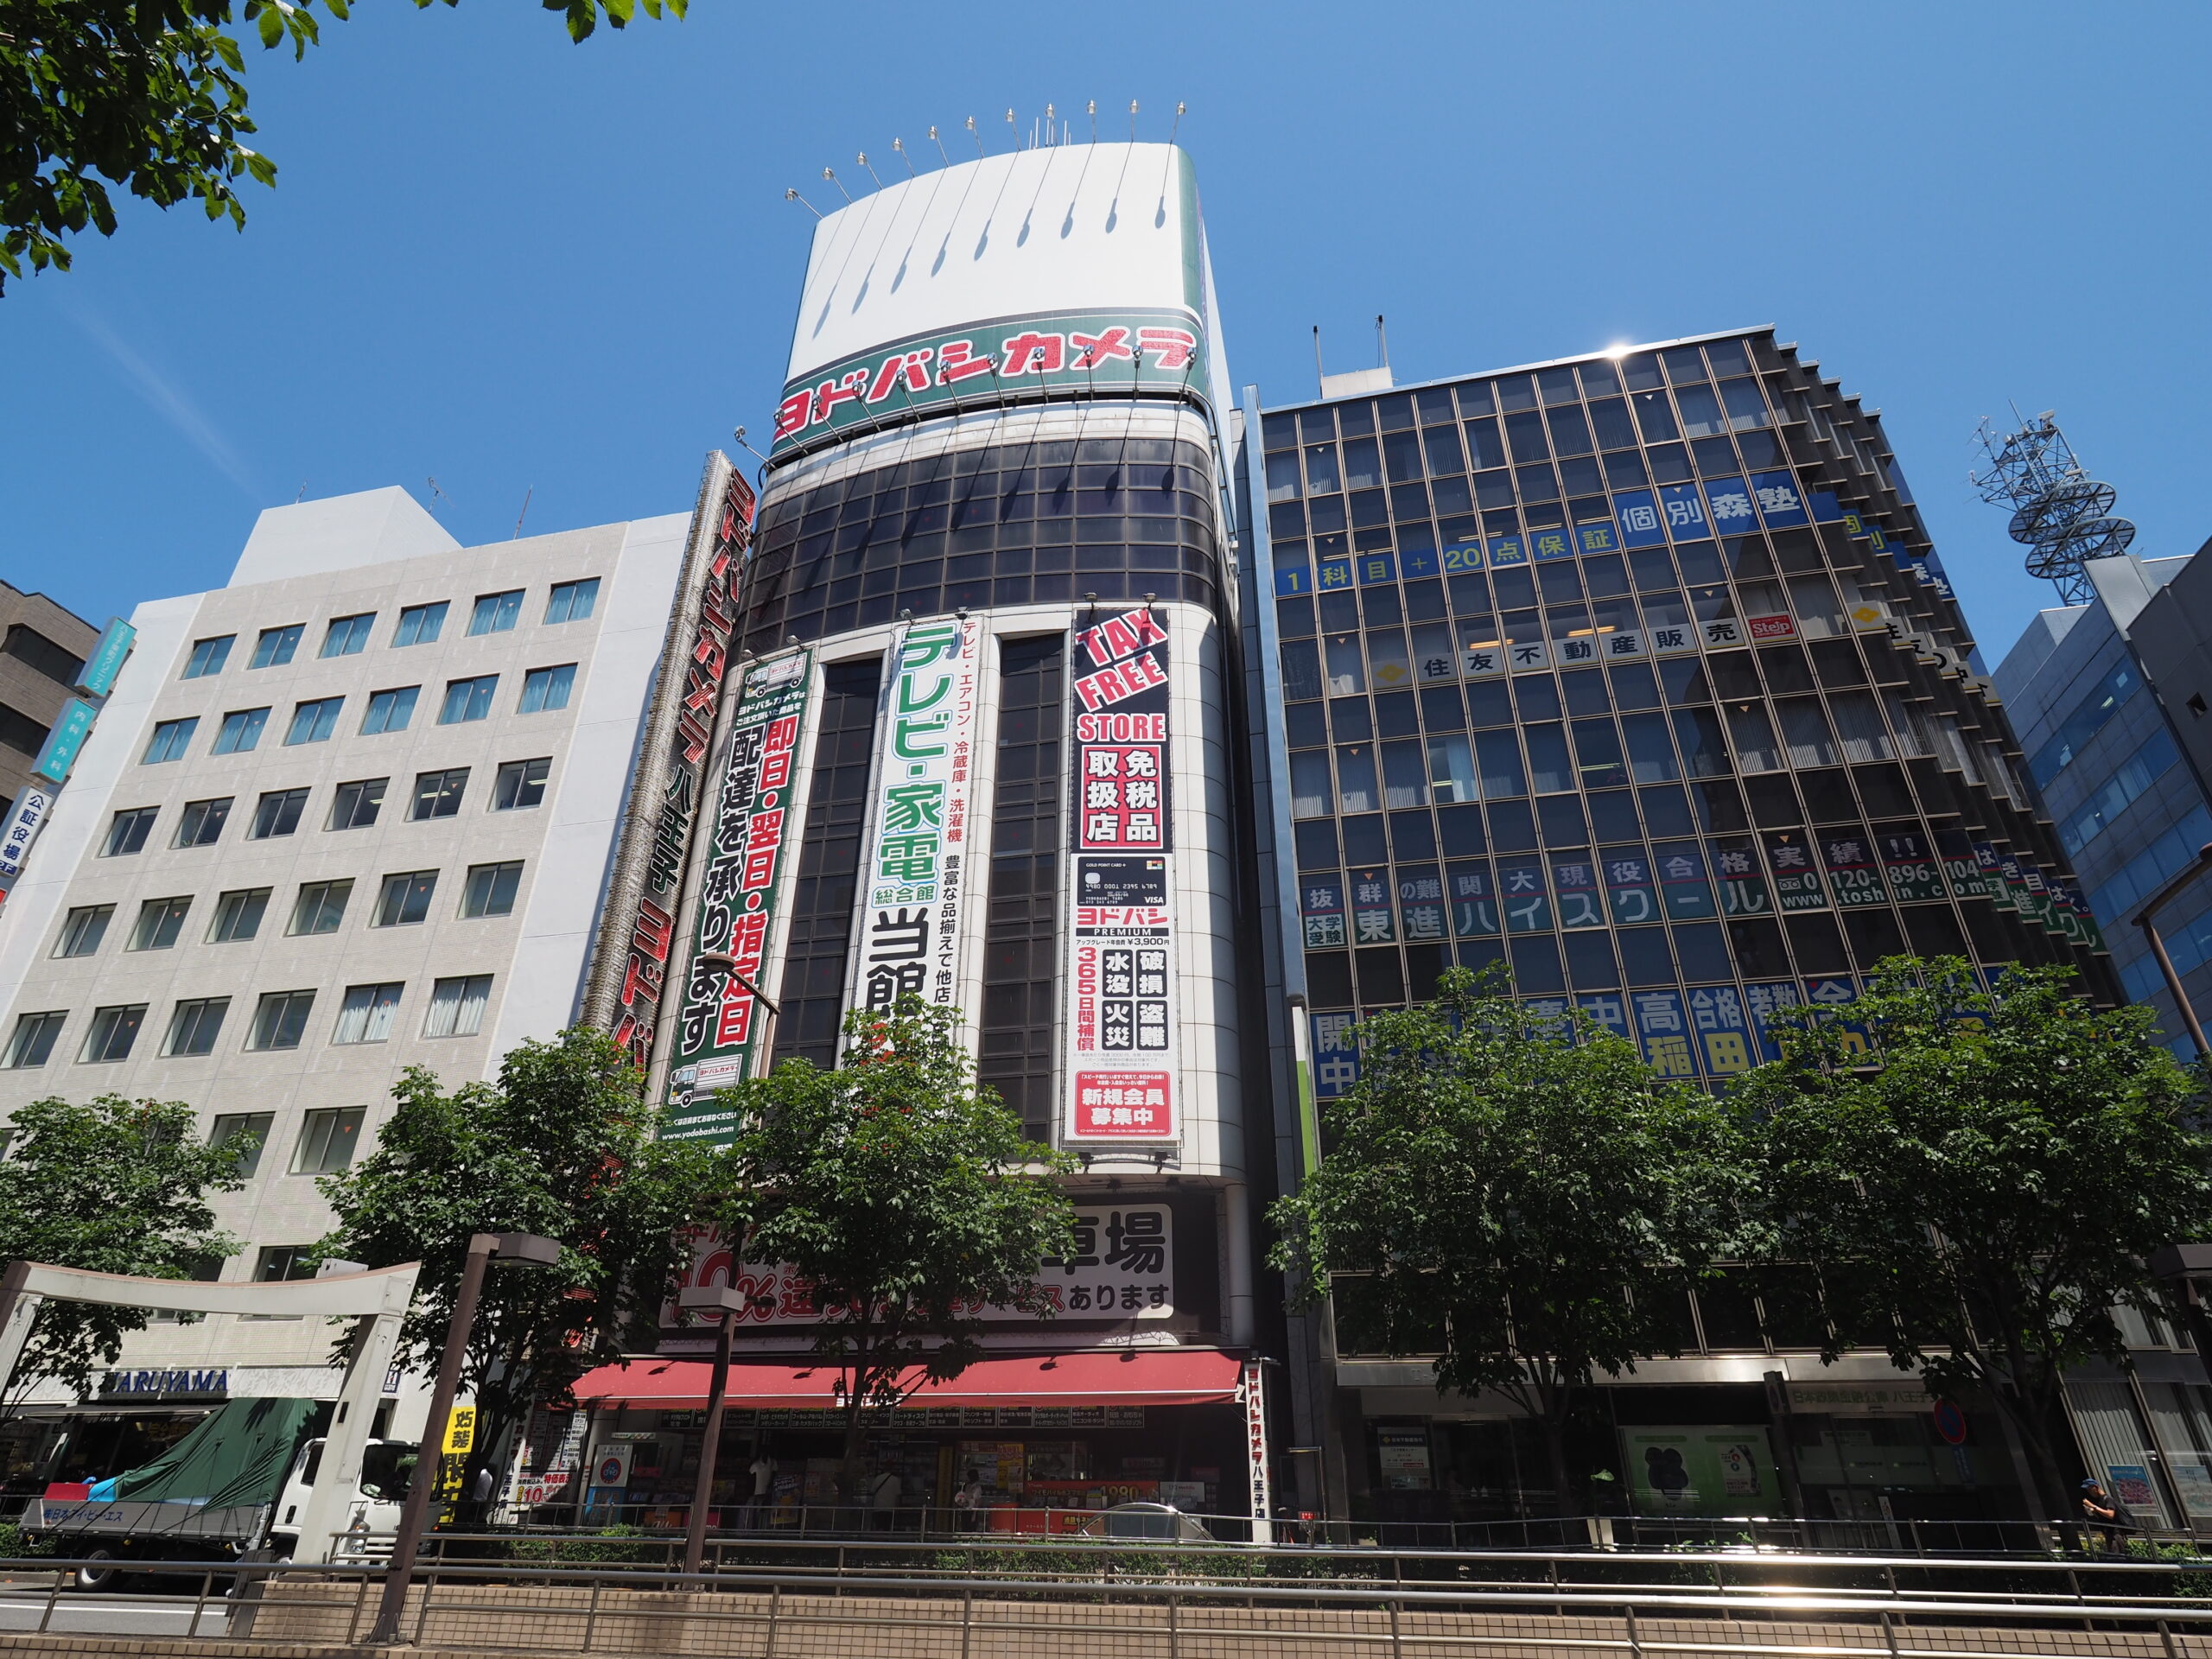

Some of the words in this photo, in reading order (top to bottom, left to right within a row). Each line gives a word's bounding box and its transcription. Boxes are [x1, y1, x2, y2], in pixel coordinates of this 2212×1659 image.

[773, 326, 1195, 440] ヨドバシカメラ
[1622, 486, 1800, 532] 個別森塾
[679, 467, 758, 764] ヨドバシカメラ
[1076, 608, 1168, 667] TAX
[1424, 623, 1738, 678] 住友不動産販売
[1075, 651, 1168, 712] FREE
[1077, 713, 1166, 742] STORE
[1087, 749, 1120, 842] 取扱店
[1125, 749, 1158, 842] 免税品
[3, 794, 45, 861] 公証役場
[650, 764, 693, 893] 八王子
[681, 722, 767, 1056] 配達を承ります
[875, 885, 935, 905] 総合館
[1077, 908, 1168, 925] ヨドバシ
[1357, 880, 1764, 942] 東進ハイスクール
[1077, 946, 1096, 1052] 365日間補償
[1105, 951, 1130, 994] 水没
[1139, 951, 1165, 995] 破損
[1105, 1003, 1130, 1047] 火災
[1139, 1003, 1165, 1047] 盗難
[1082, 1088, 1165, 1106] 新規会員
[1091, 1108, 1154, 1126] 募集中
[662, 1125, 734, 1141] www.yodobashi.com
[1070, 1285, 1169, 1311] あります
[1248, 1369, 1266, 1518] ヨドバシカメラ八王子店
